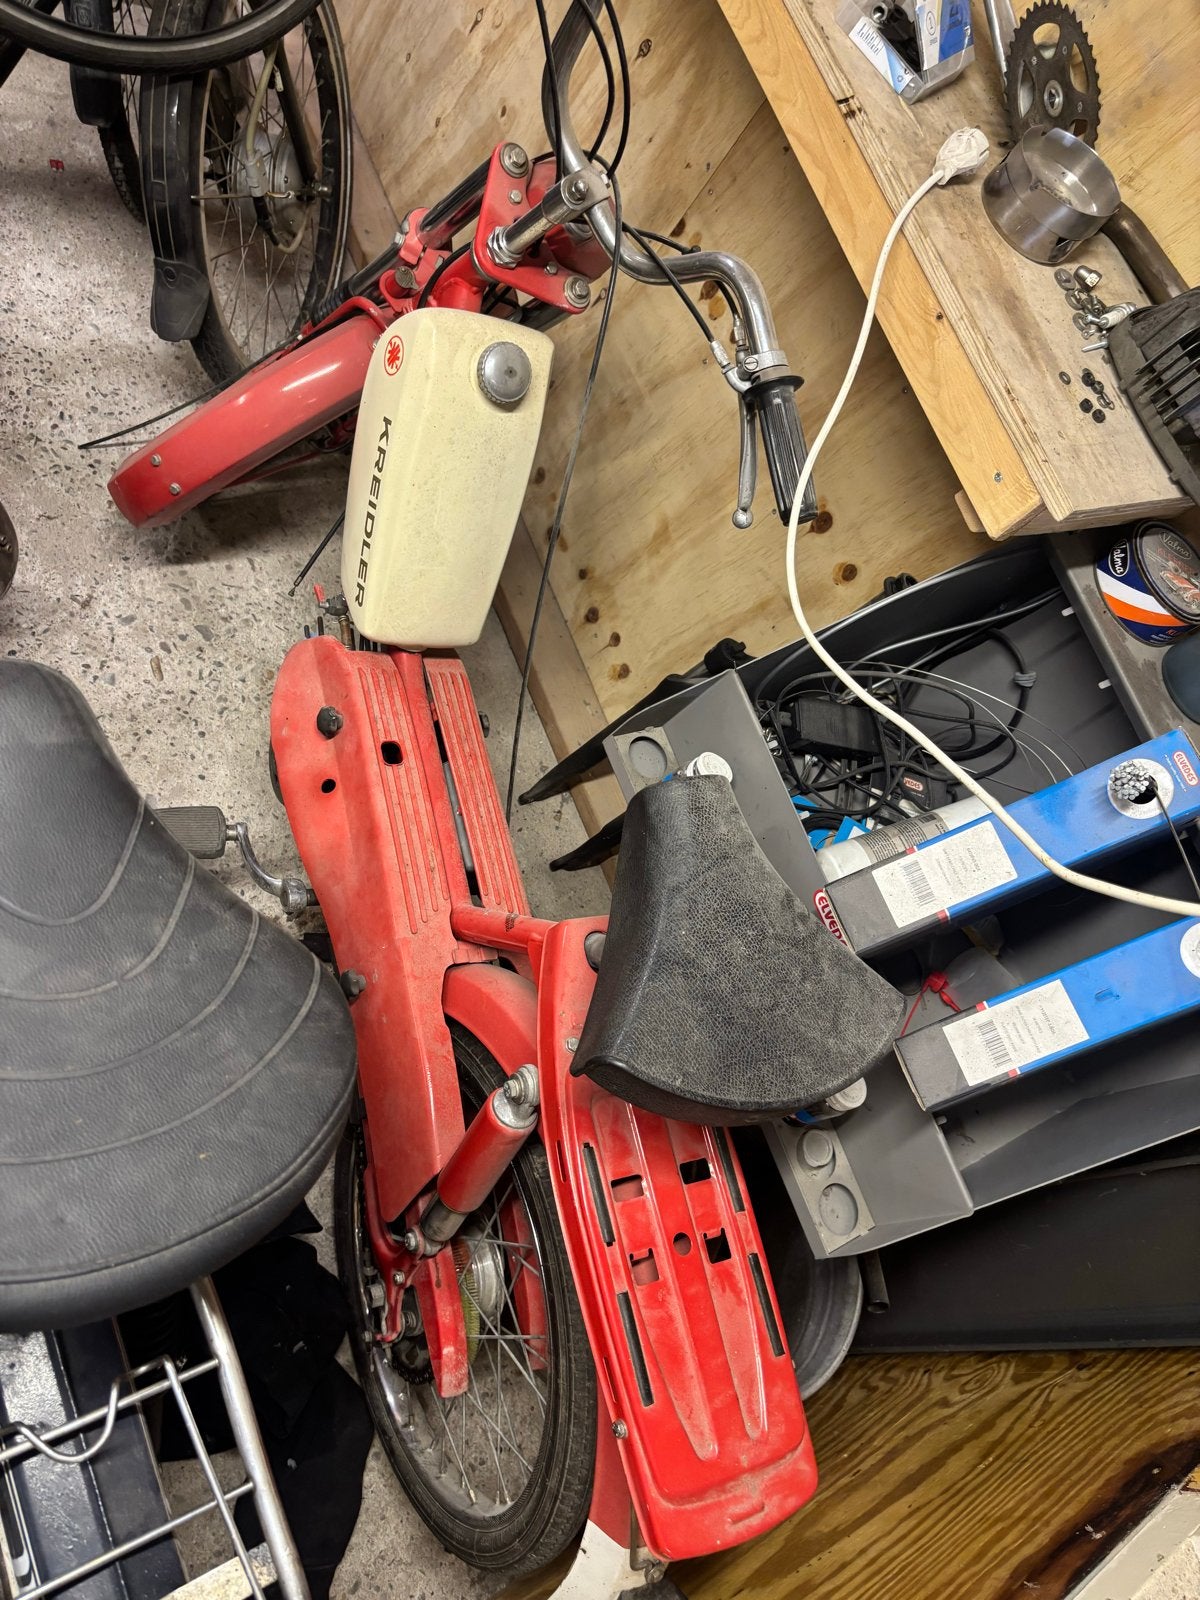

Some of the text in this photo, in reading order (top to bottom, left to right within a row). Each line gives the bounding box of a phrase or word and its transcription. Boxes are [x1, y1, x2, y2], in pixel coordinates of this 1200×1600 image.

[355, 415, 393, 608] KREIDLER
[1161, 532, 1191, 557] Valma
[1175, 752, 1197, 783] ELVEDES
[817, 896, 849, 947] ELVED
